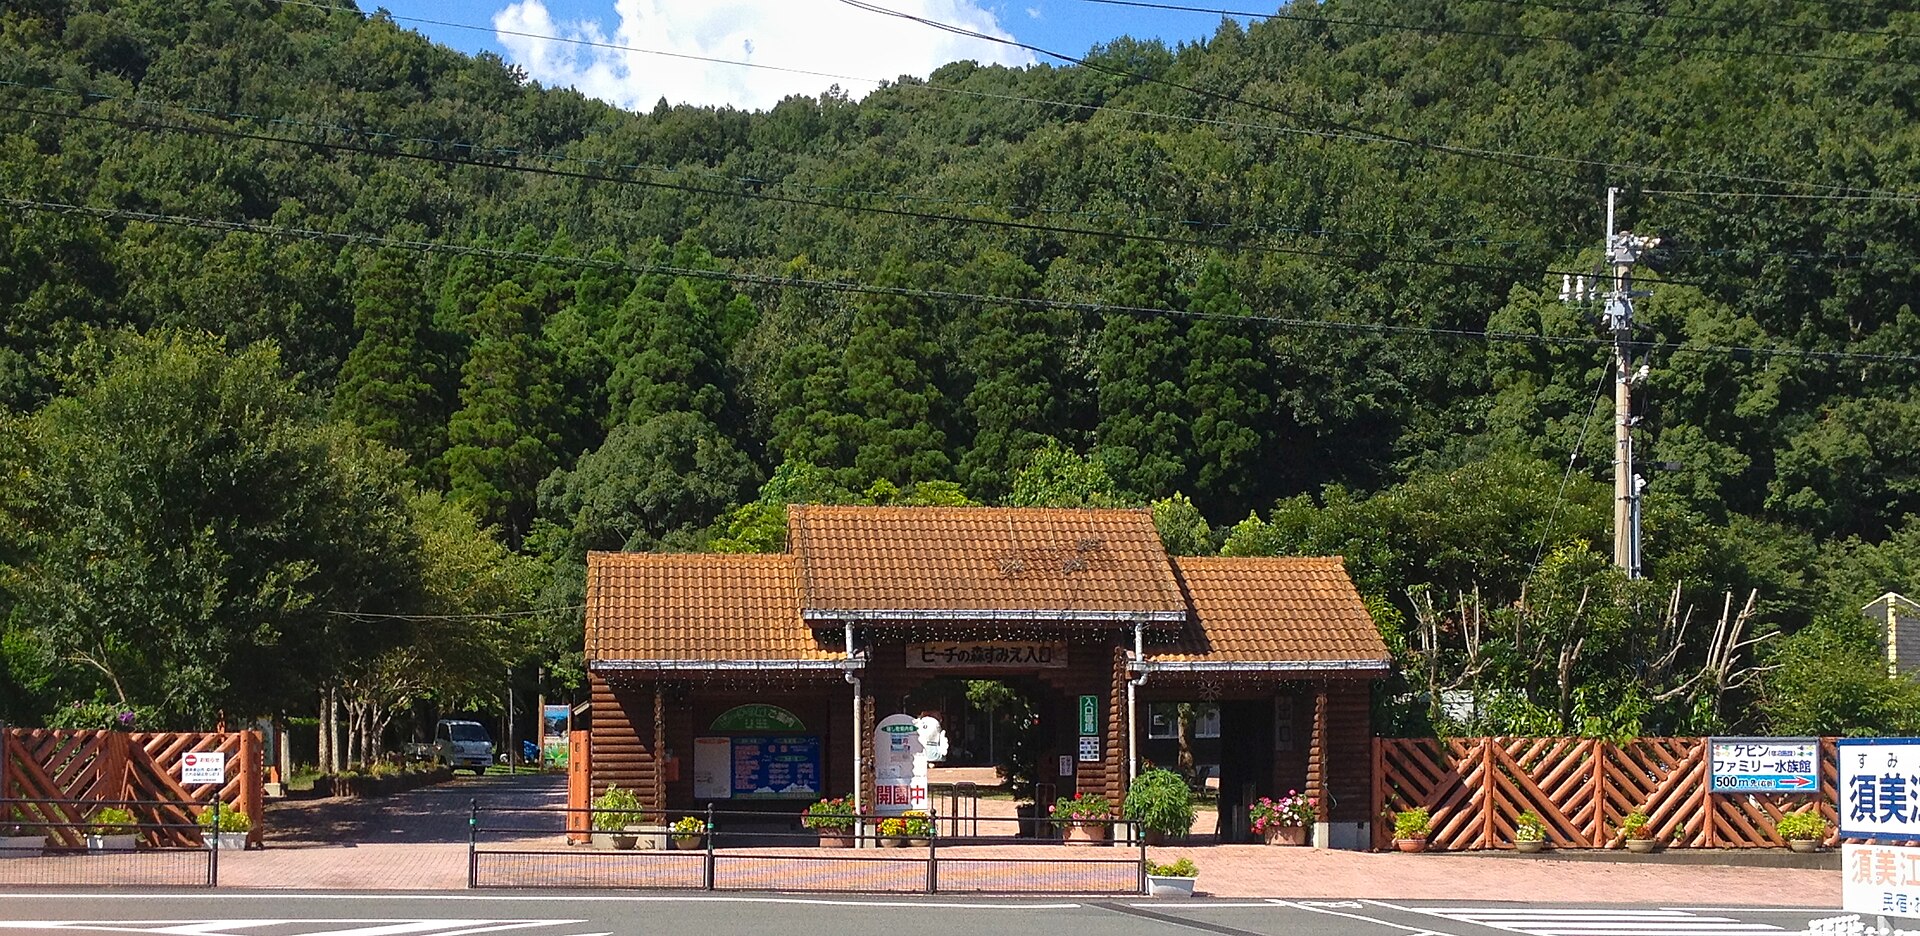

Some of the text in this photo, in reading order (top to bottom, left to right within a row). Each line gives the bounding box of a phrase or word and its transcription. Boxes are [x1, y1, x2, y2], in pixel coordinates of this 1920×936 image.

[1734, 744, 1769, 757] ケビン
[1714, 760, 1811, 773] ファミリー水族館
[876, 785, 925, 805] 開園中
